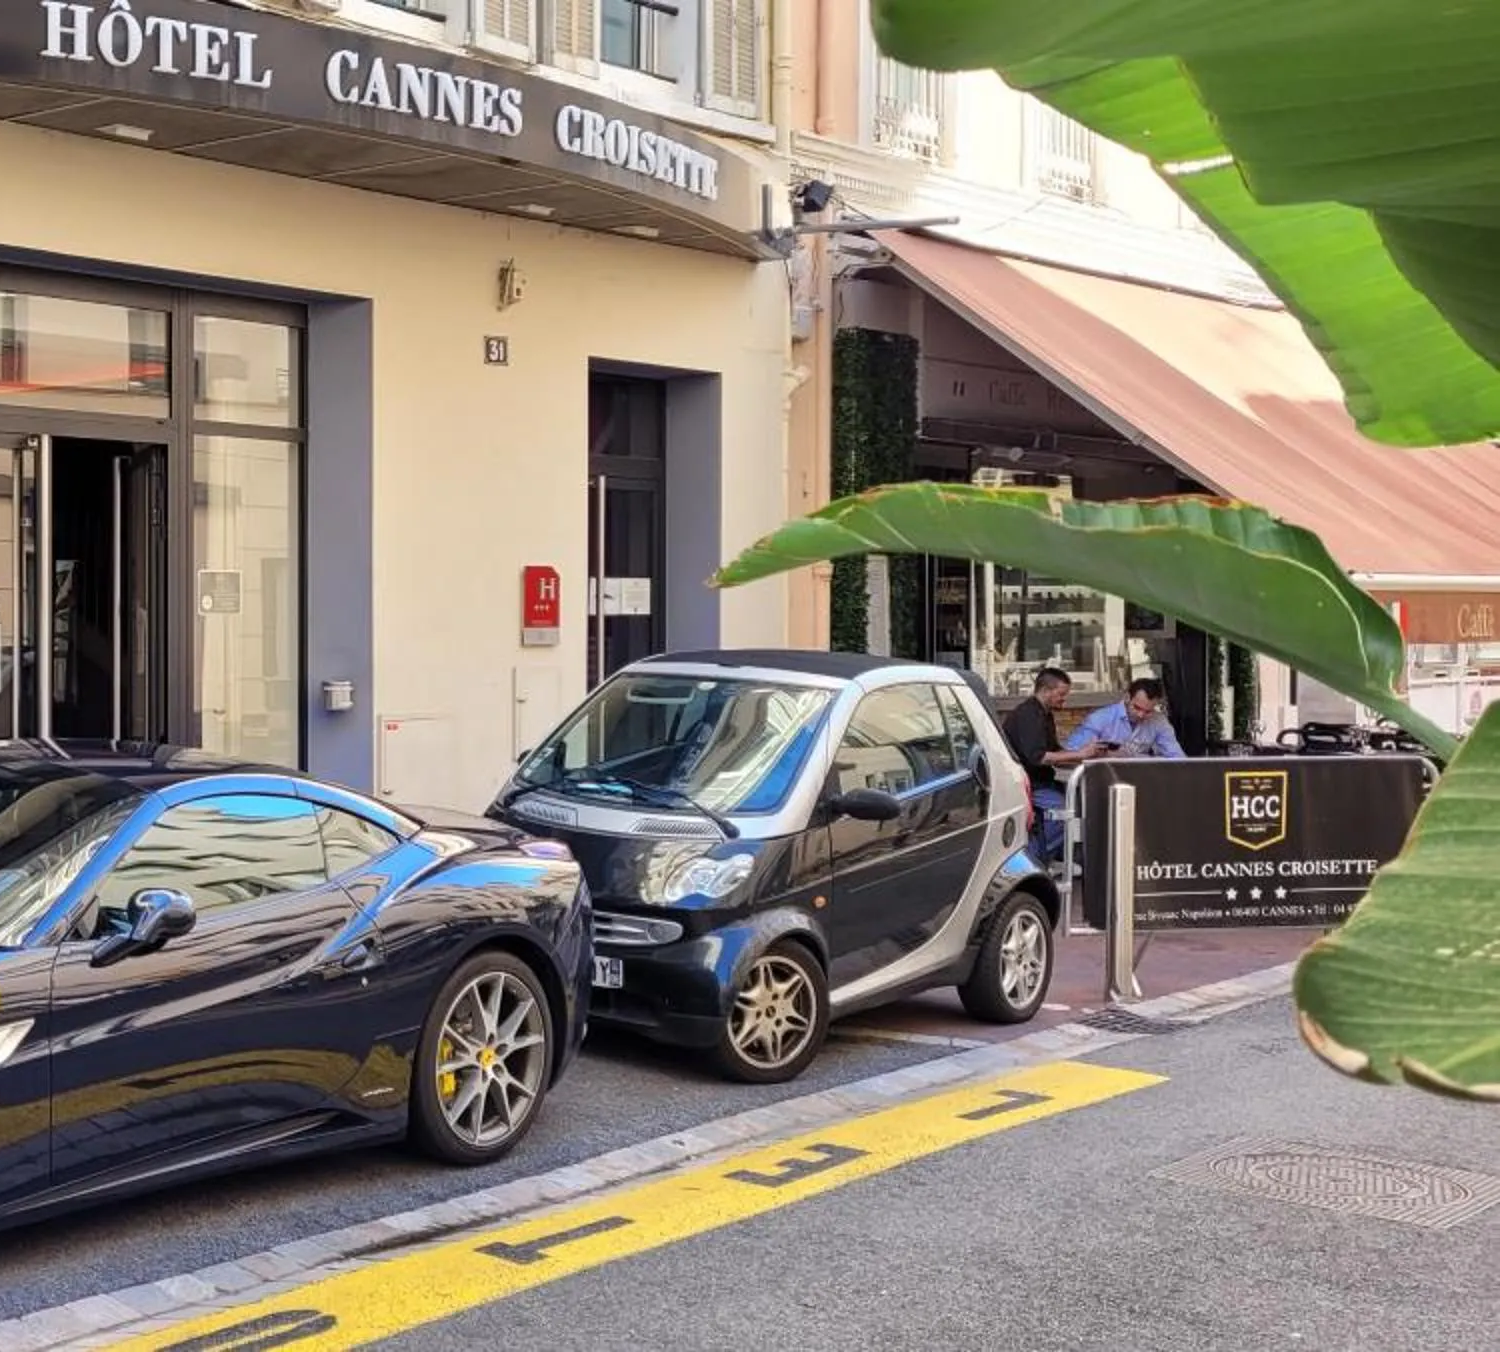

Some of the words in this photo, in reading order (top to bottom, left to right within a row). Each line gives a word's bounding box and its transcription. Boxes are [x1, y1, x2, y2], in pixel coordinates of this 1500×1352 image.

[40, 0, 273, 89] HÔTEL
[326, 49, 523, 137] CANNES
[556, 105, 718, 200] CROISETTE
[489, 340, 504, 361] 31
[540, 577, 556, 601] H
[1231, 795, 1280, 819] HCC
[1137, 860, 1197, 880] HÔTEL
[1202, 861, 1274, 879] CANNES
[1279, 859, 1378, 876] CROISETTE
[1261, 904, 1305, 917] CANNES
